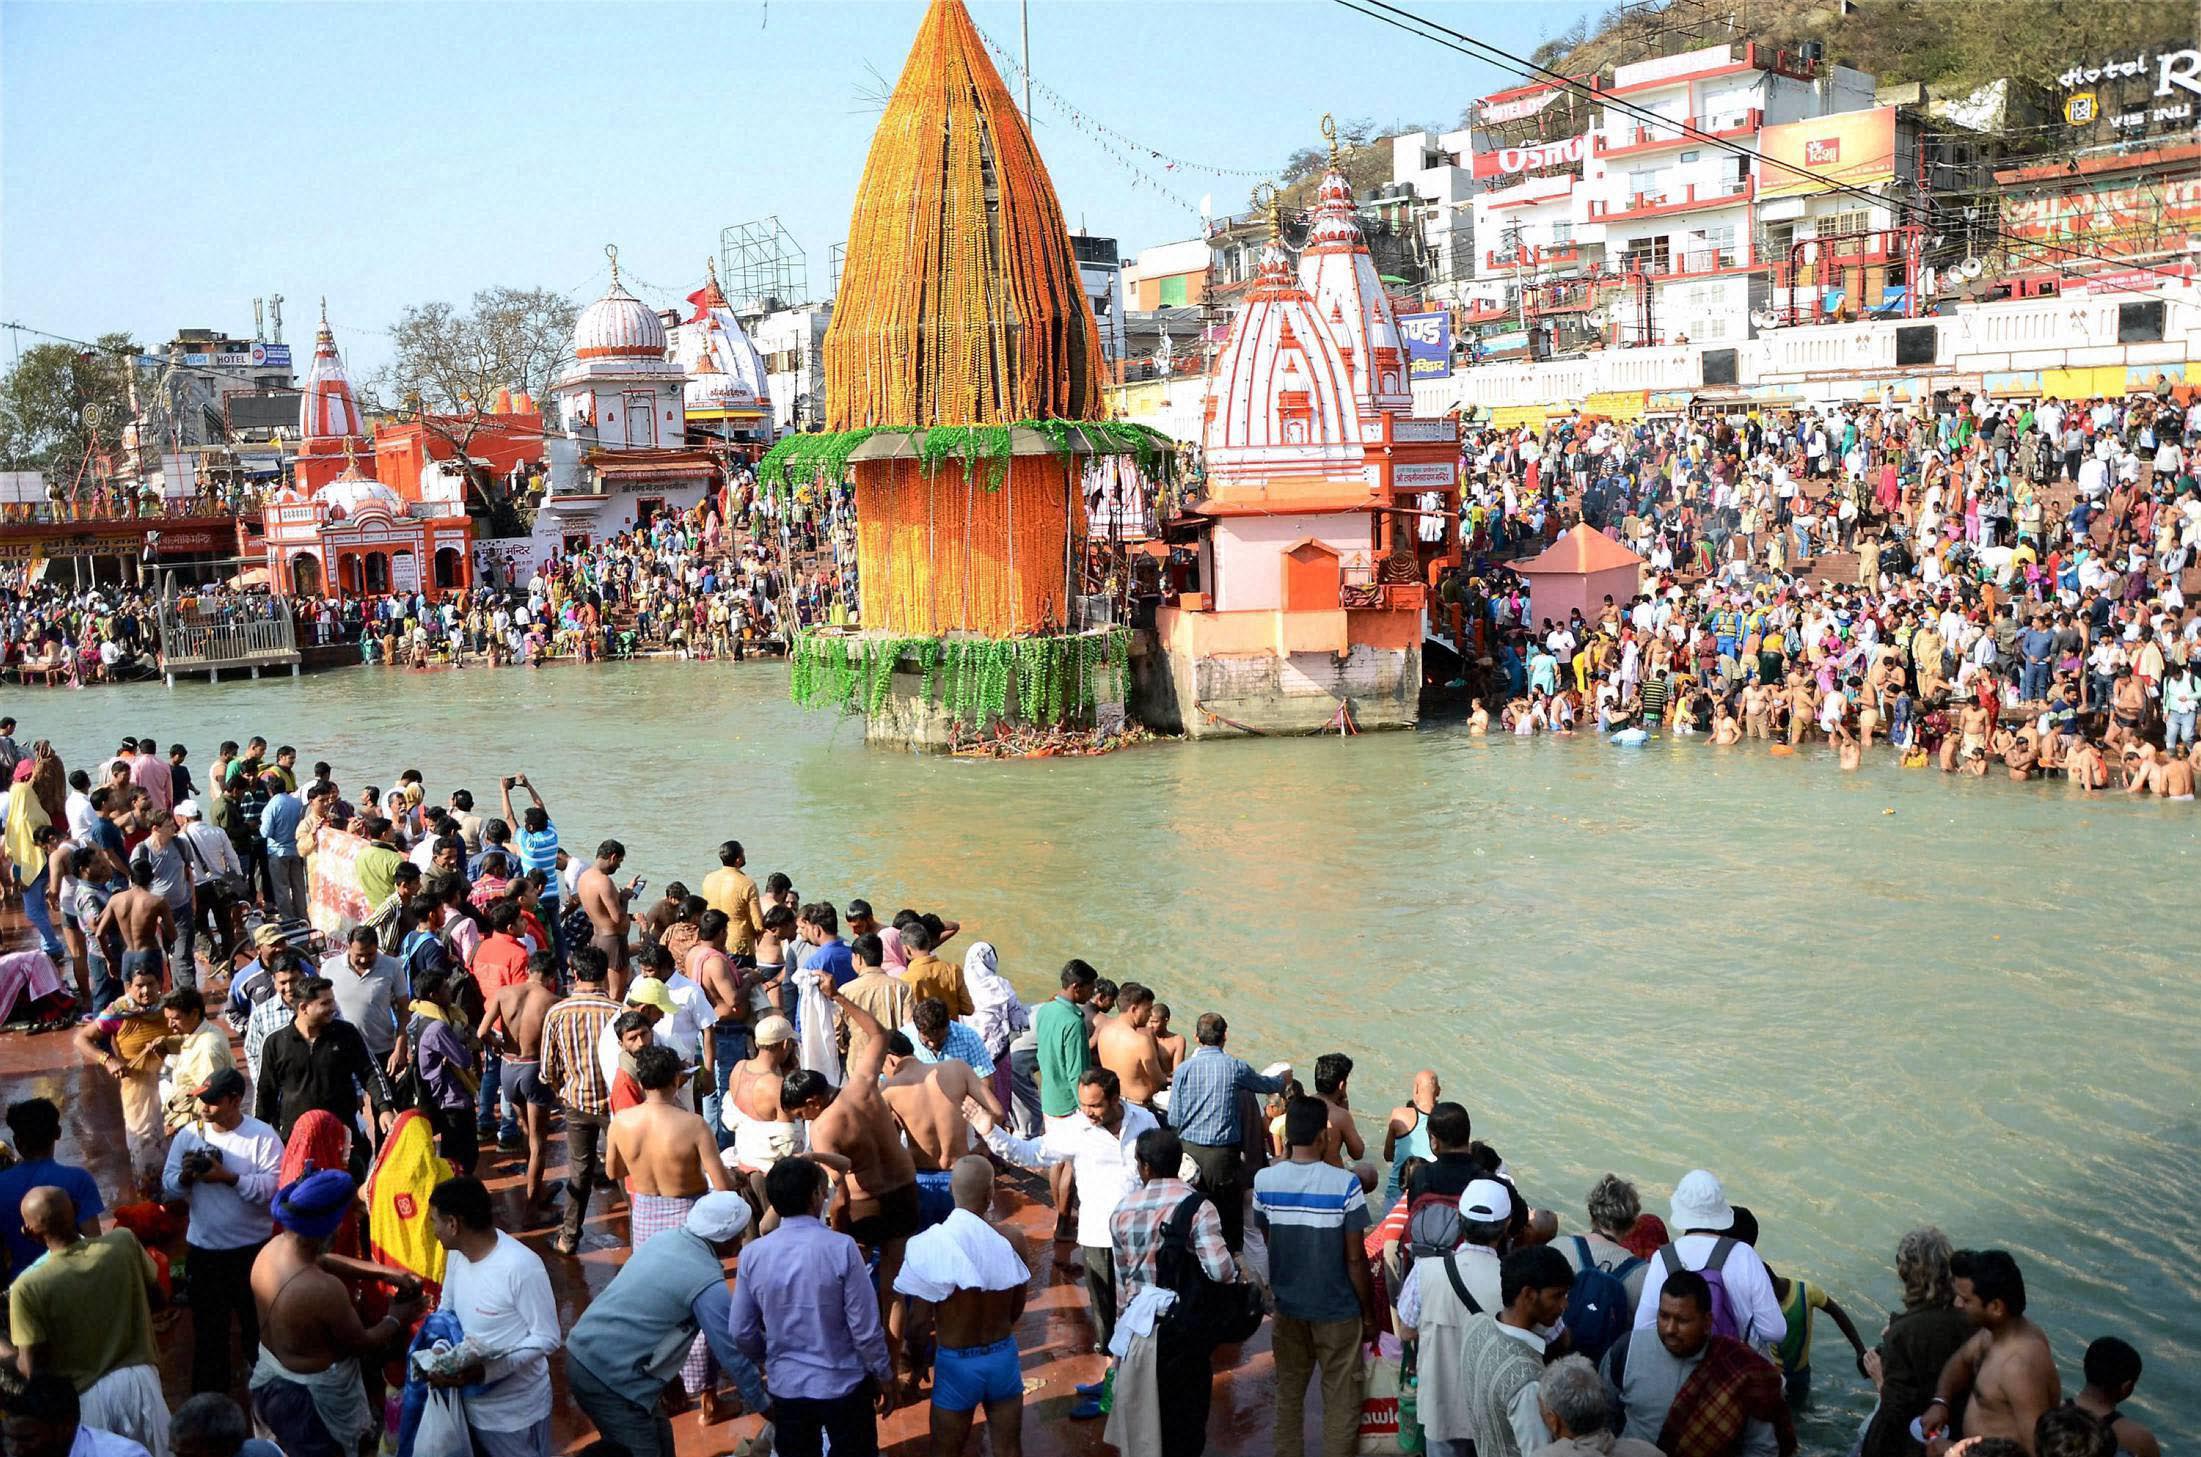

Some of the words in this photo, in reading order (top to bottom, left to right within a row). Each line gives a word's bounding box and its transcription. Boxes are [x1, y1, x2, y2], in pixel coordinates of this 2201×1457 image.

[2059, 55, 2148, 88] Hotel
[217, 353, 246, 364] HOTEL
[505, 543, 530, 556] मन्दिर
